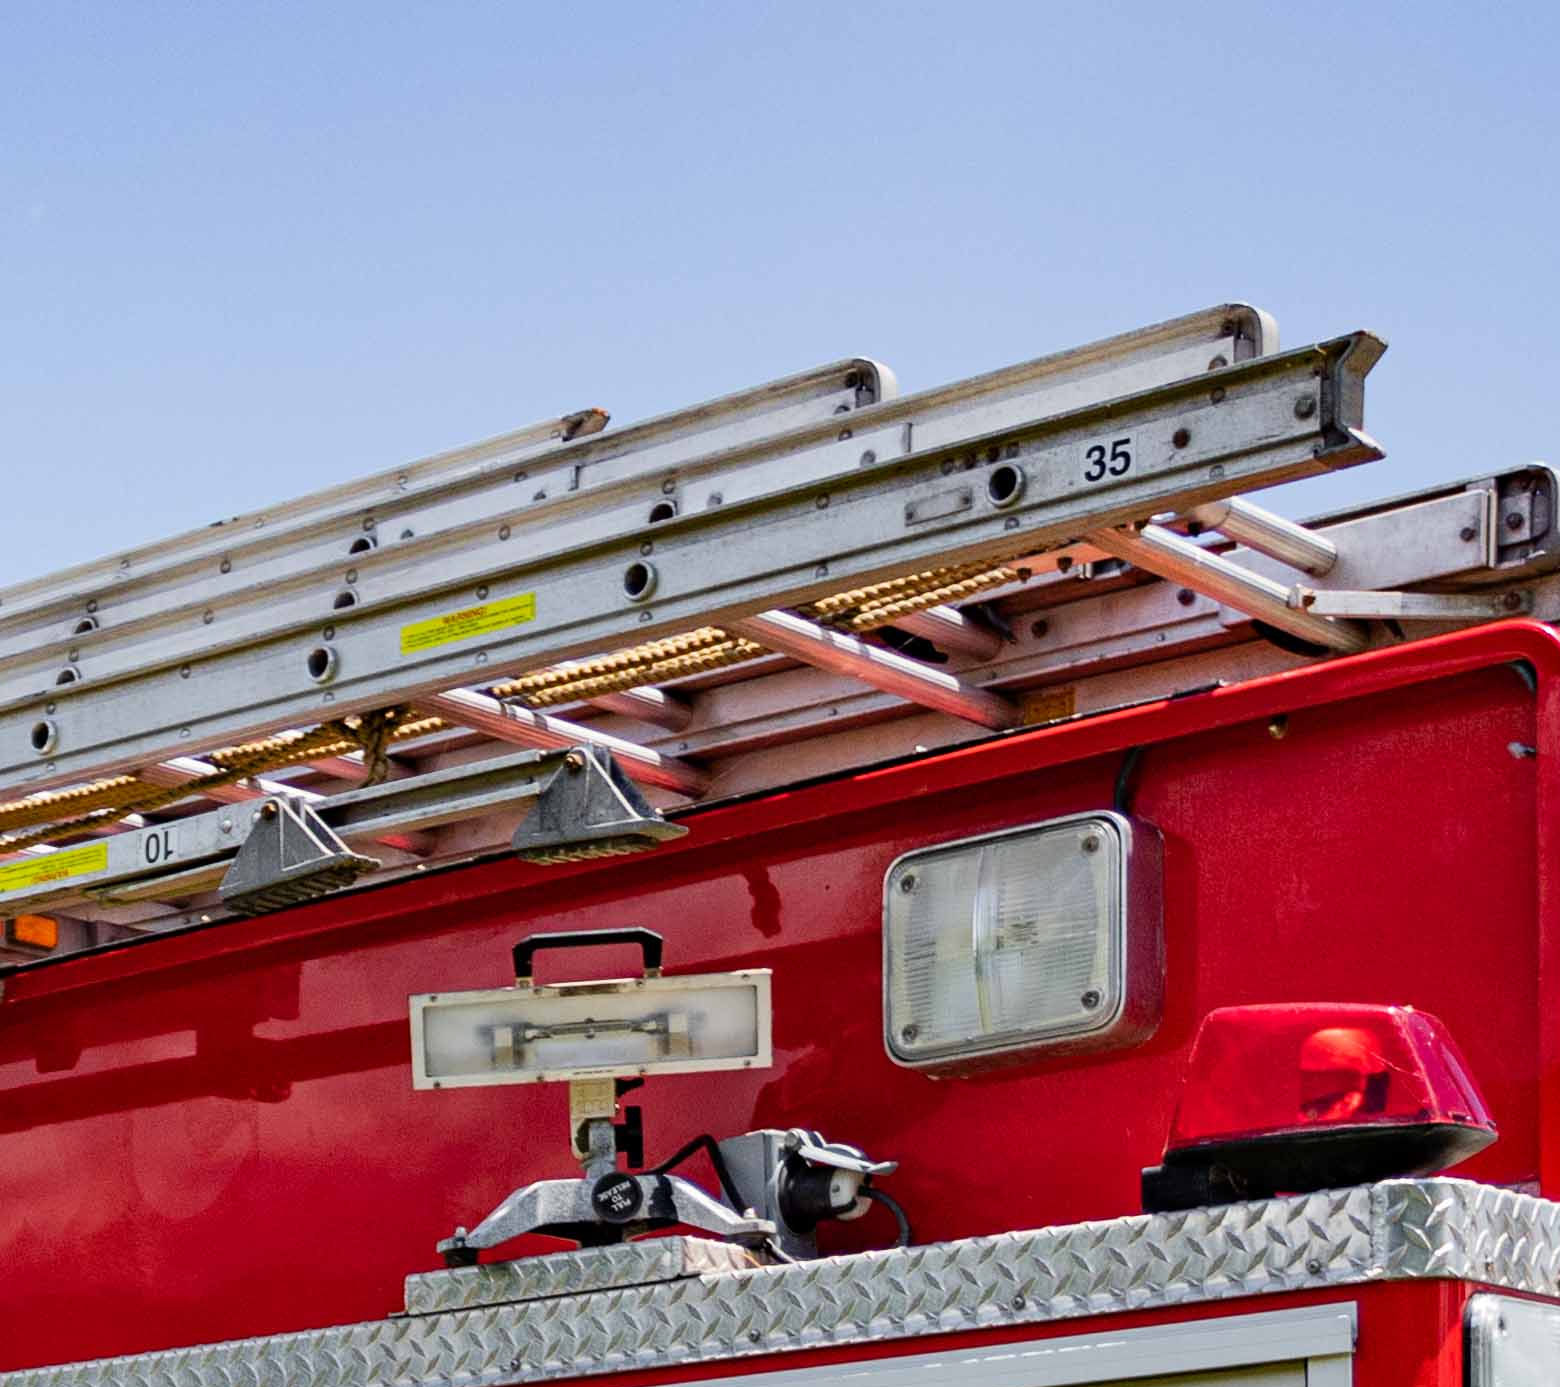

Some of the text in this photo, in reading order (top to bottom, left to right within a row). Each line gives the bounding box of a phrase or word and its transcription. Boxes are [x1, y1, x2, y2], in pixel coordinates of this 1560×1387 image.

[1084, 437, 1131, 482] 35
[145, 830, 173, 863] 10
[597, 1180, 632, 1202] RELEASE
[611, 1193, 623, 1203] TO
